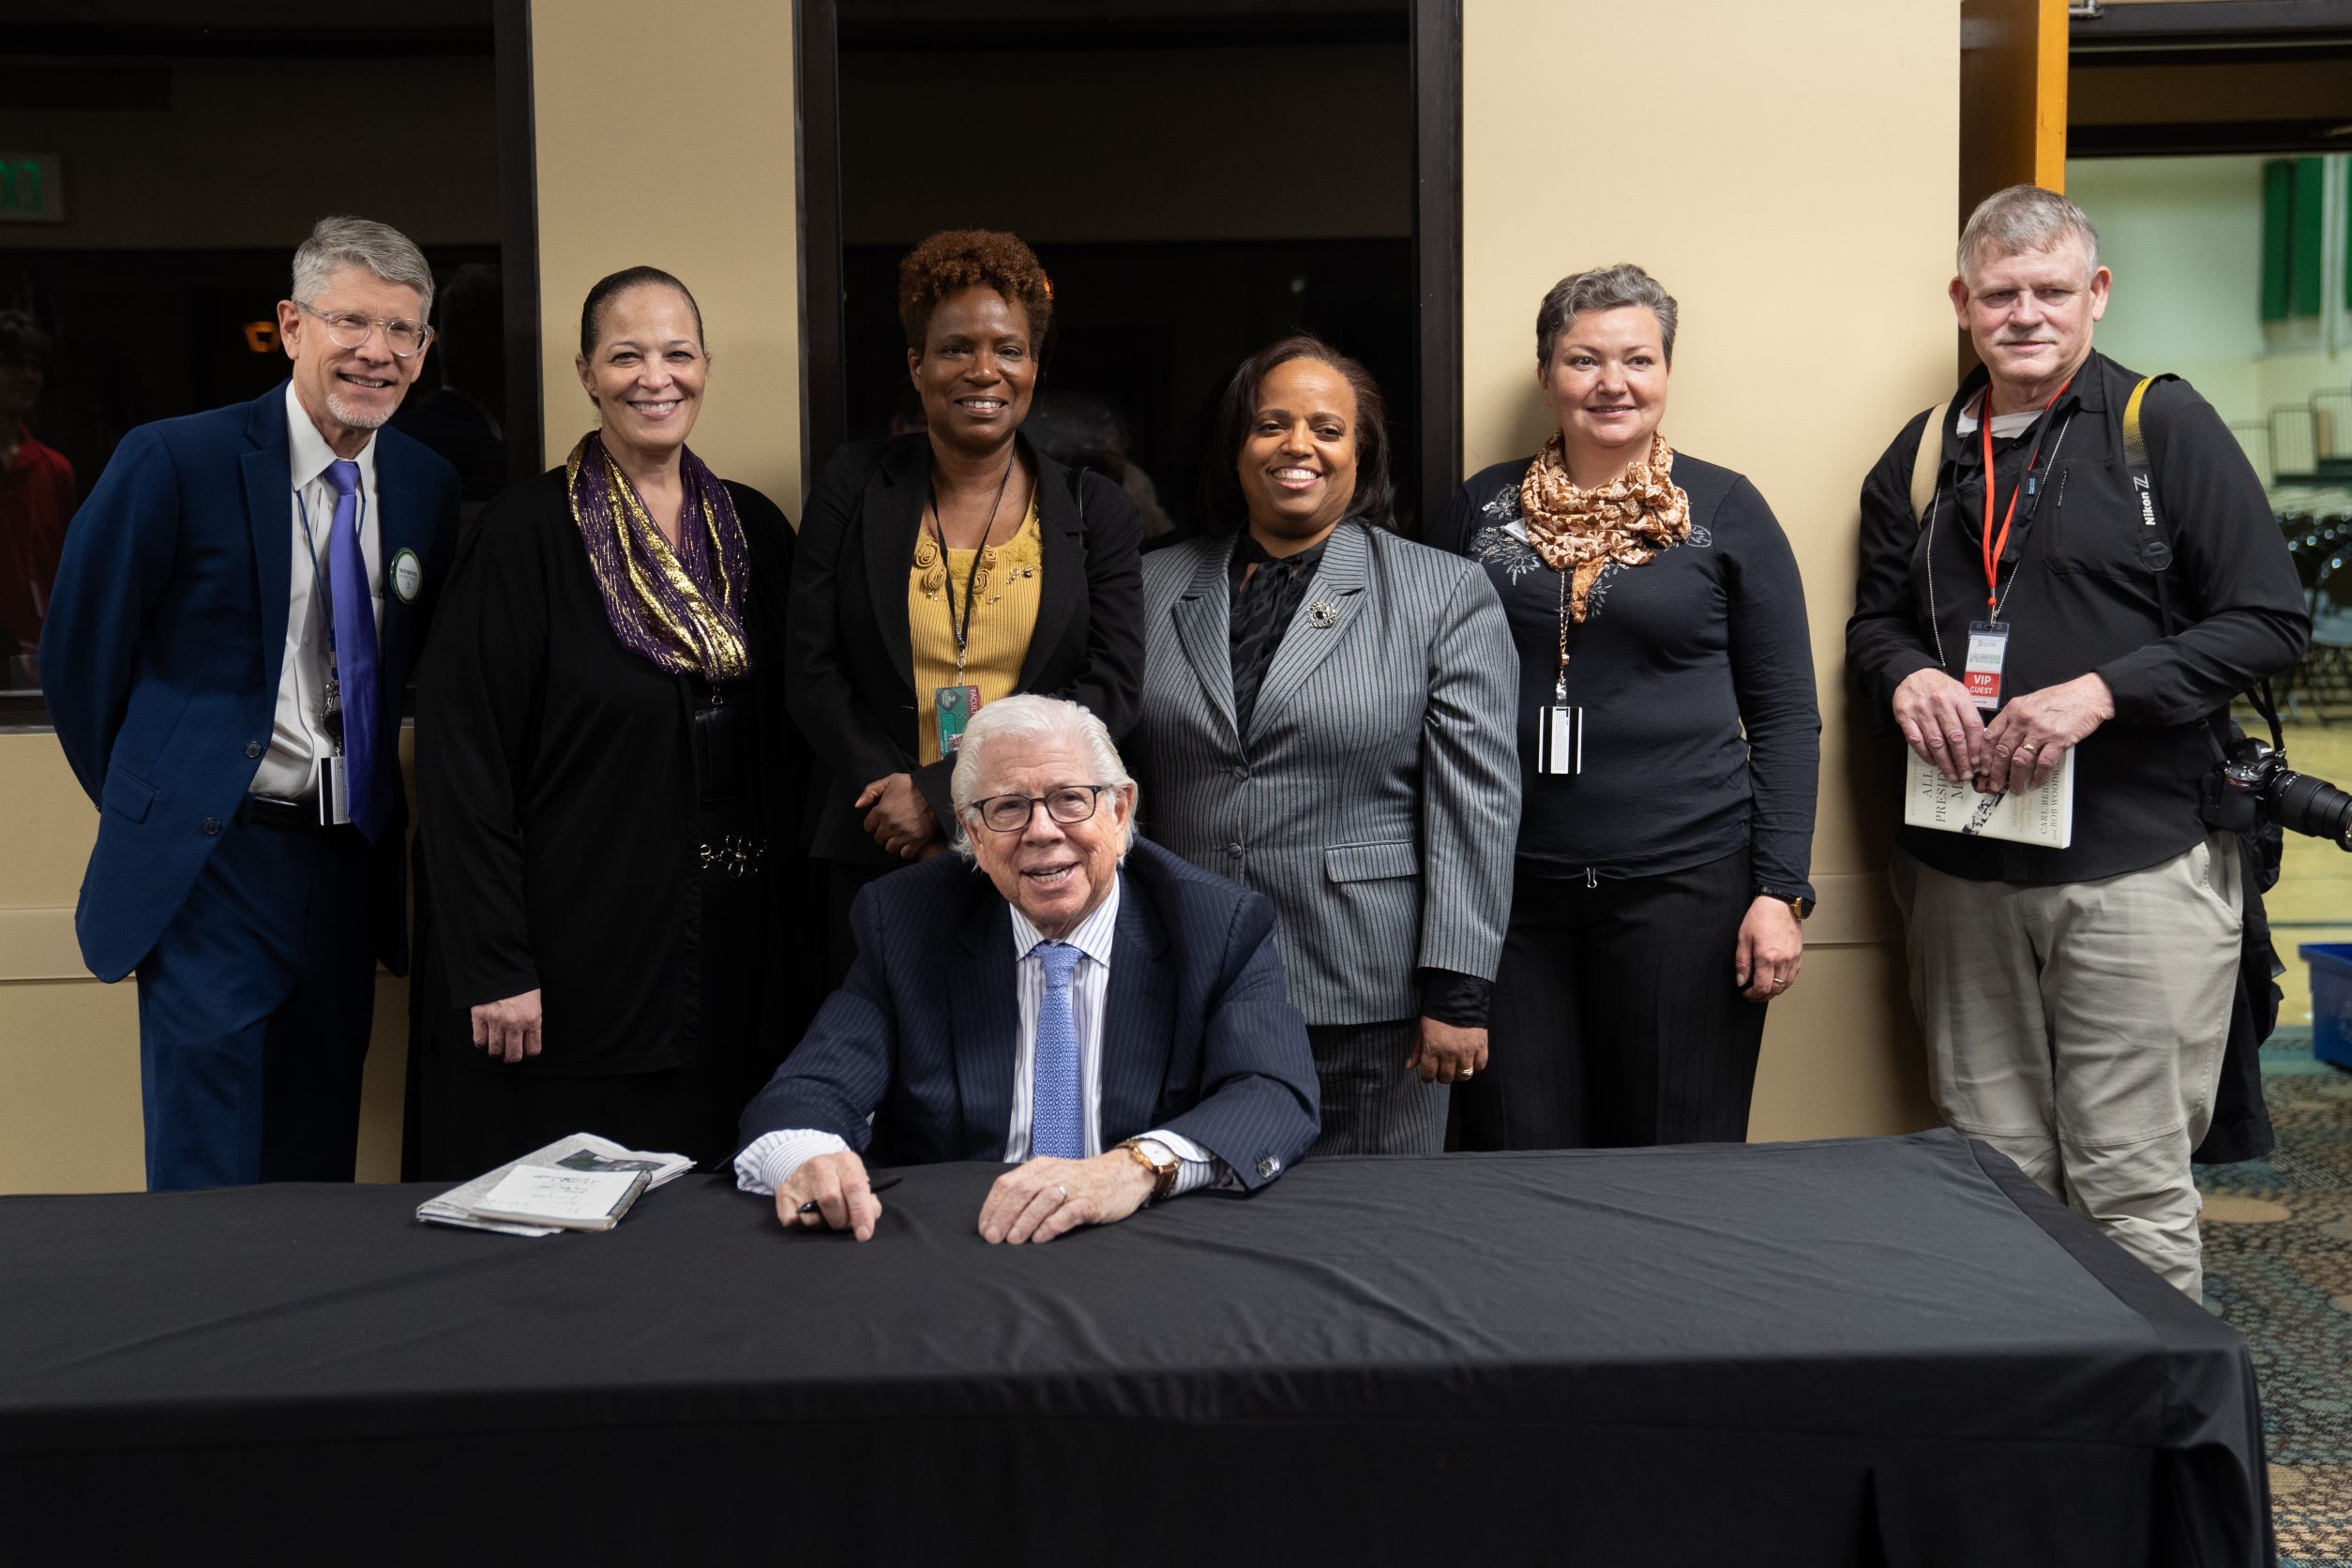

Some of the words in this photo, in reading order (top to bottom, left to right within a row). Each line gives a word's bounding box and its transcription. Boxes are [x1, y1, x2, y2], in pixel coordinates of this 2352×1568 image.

[2133, 474, 2149, 491] Z
[2141, 491, 2156, 526] Nikon
[1969, 686, 1993, 695] GUEST
[1973, 674, 1992, 686] VIP
[969, 689, 979, 714] FACULT
[1922, 770, 1934, 799] ALL
[2041, 780, 2049, 806] BERN
[1936, 773, 1948, 823] PRESID
[2041, 809, 2049, 835] CARL
